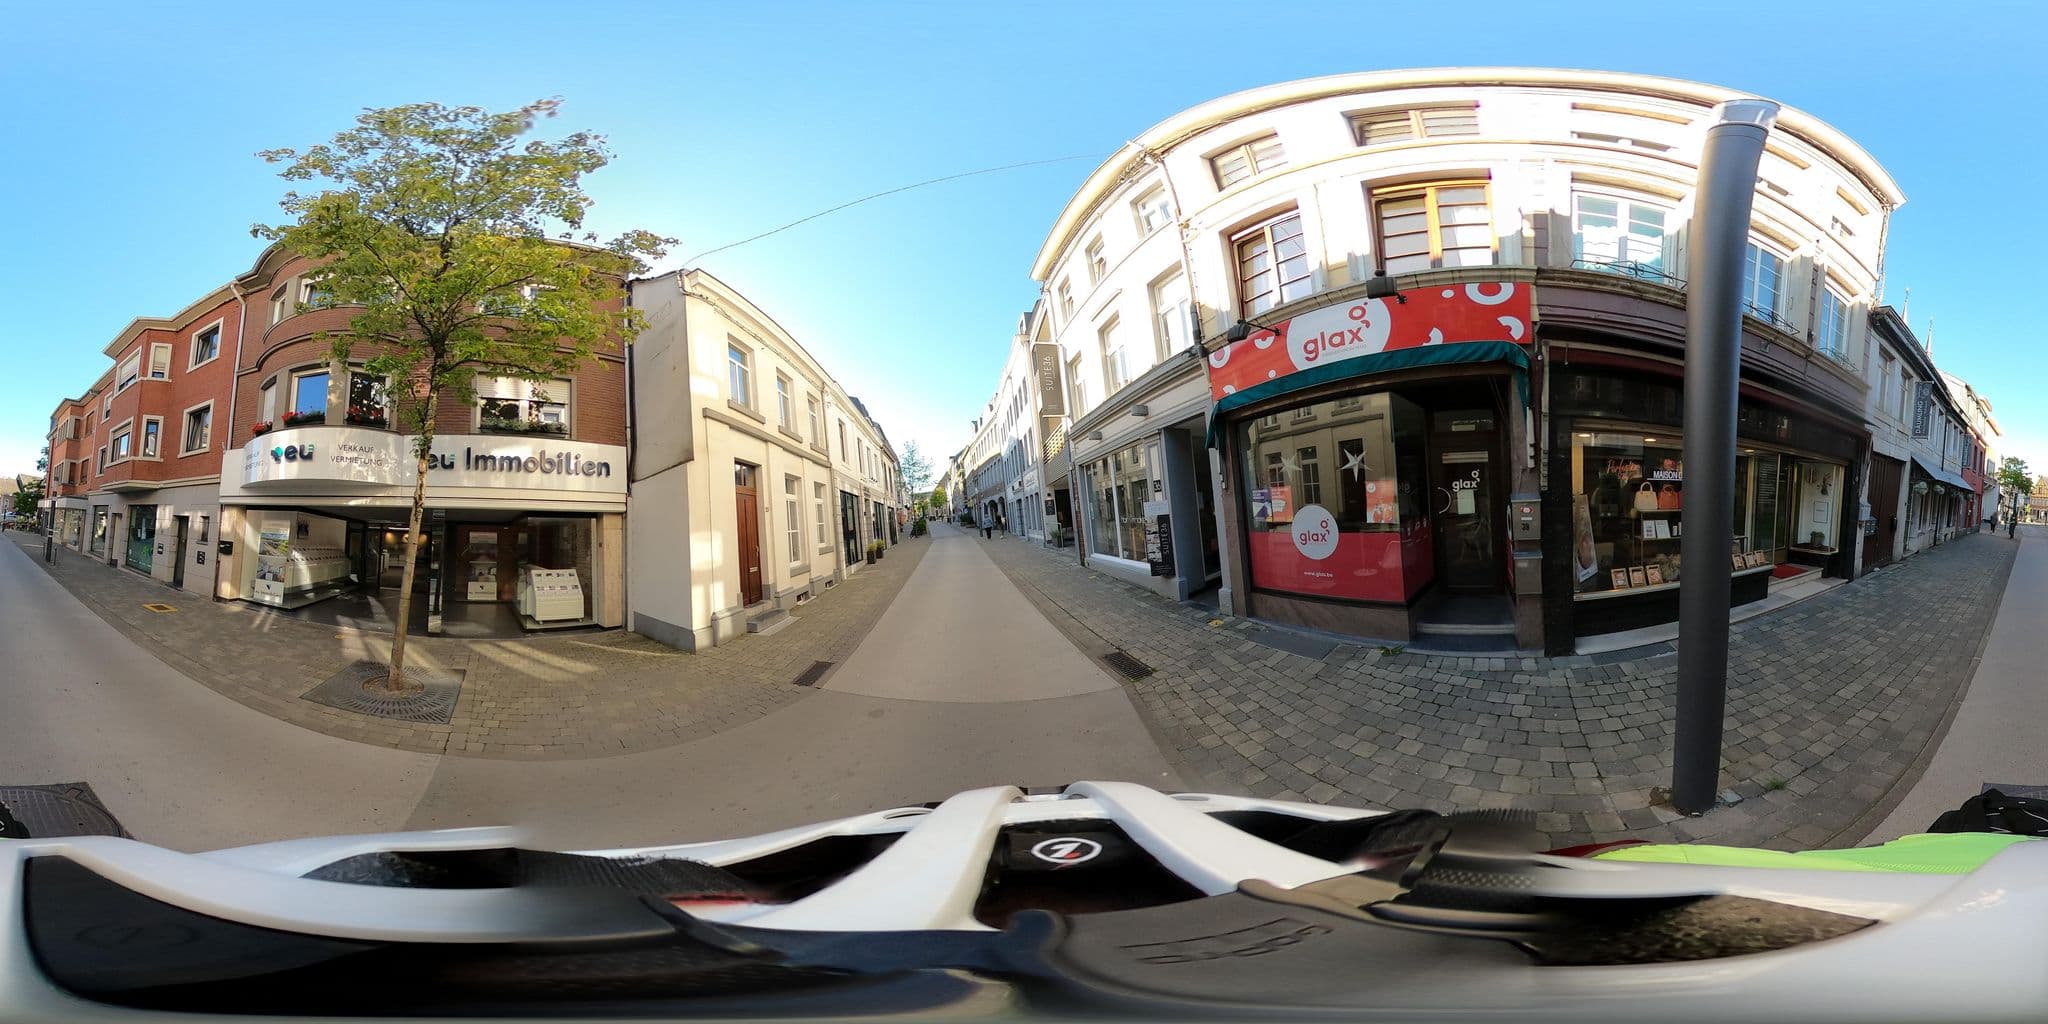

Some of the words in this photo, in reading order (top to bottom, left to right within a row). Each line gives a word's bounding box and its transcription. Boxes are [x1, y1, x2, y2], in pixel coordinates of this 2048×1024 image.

[1302, 327, 1364, 362] glax
[1042, 356, 1055, 391] SUITE36
[337, 444, 376, 454] VERKAUF
[330, 455, 383, 467] VERMIETUNG
[427, 452, 456, 470] eu
[464, 447, 611, 477] Immobilien
[1653, 470, 1678, 479] MAISON
[1452, 479, 1478, 492] glax
[1160, 523, 1171, 554] SUITE36
[1299, 530, 1328, 546] glax
